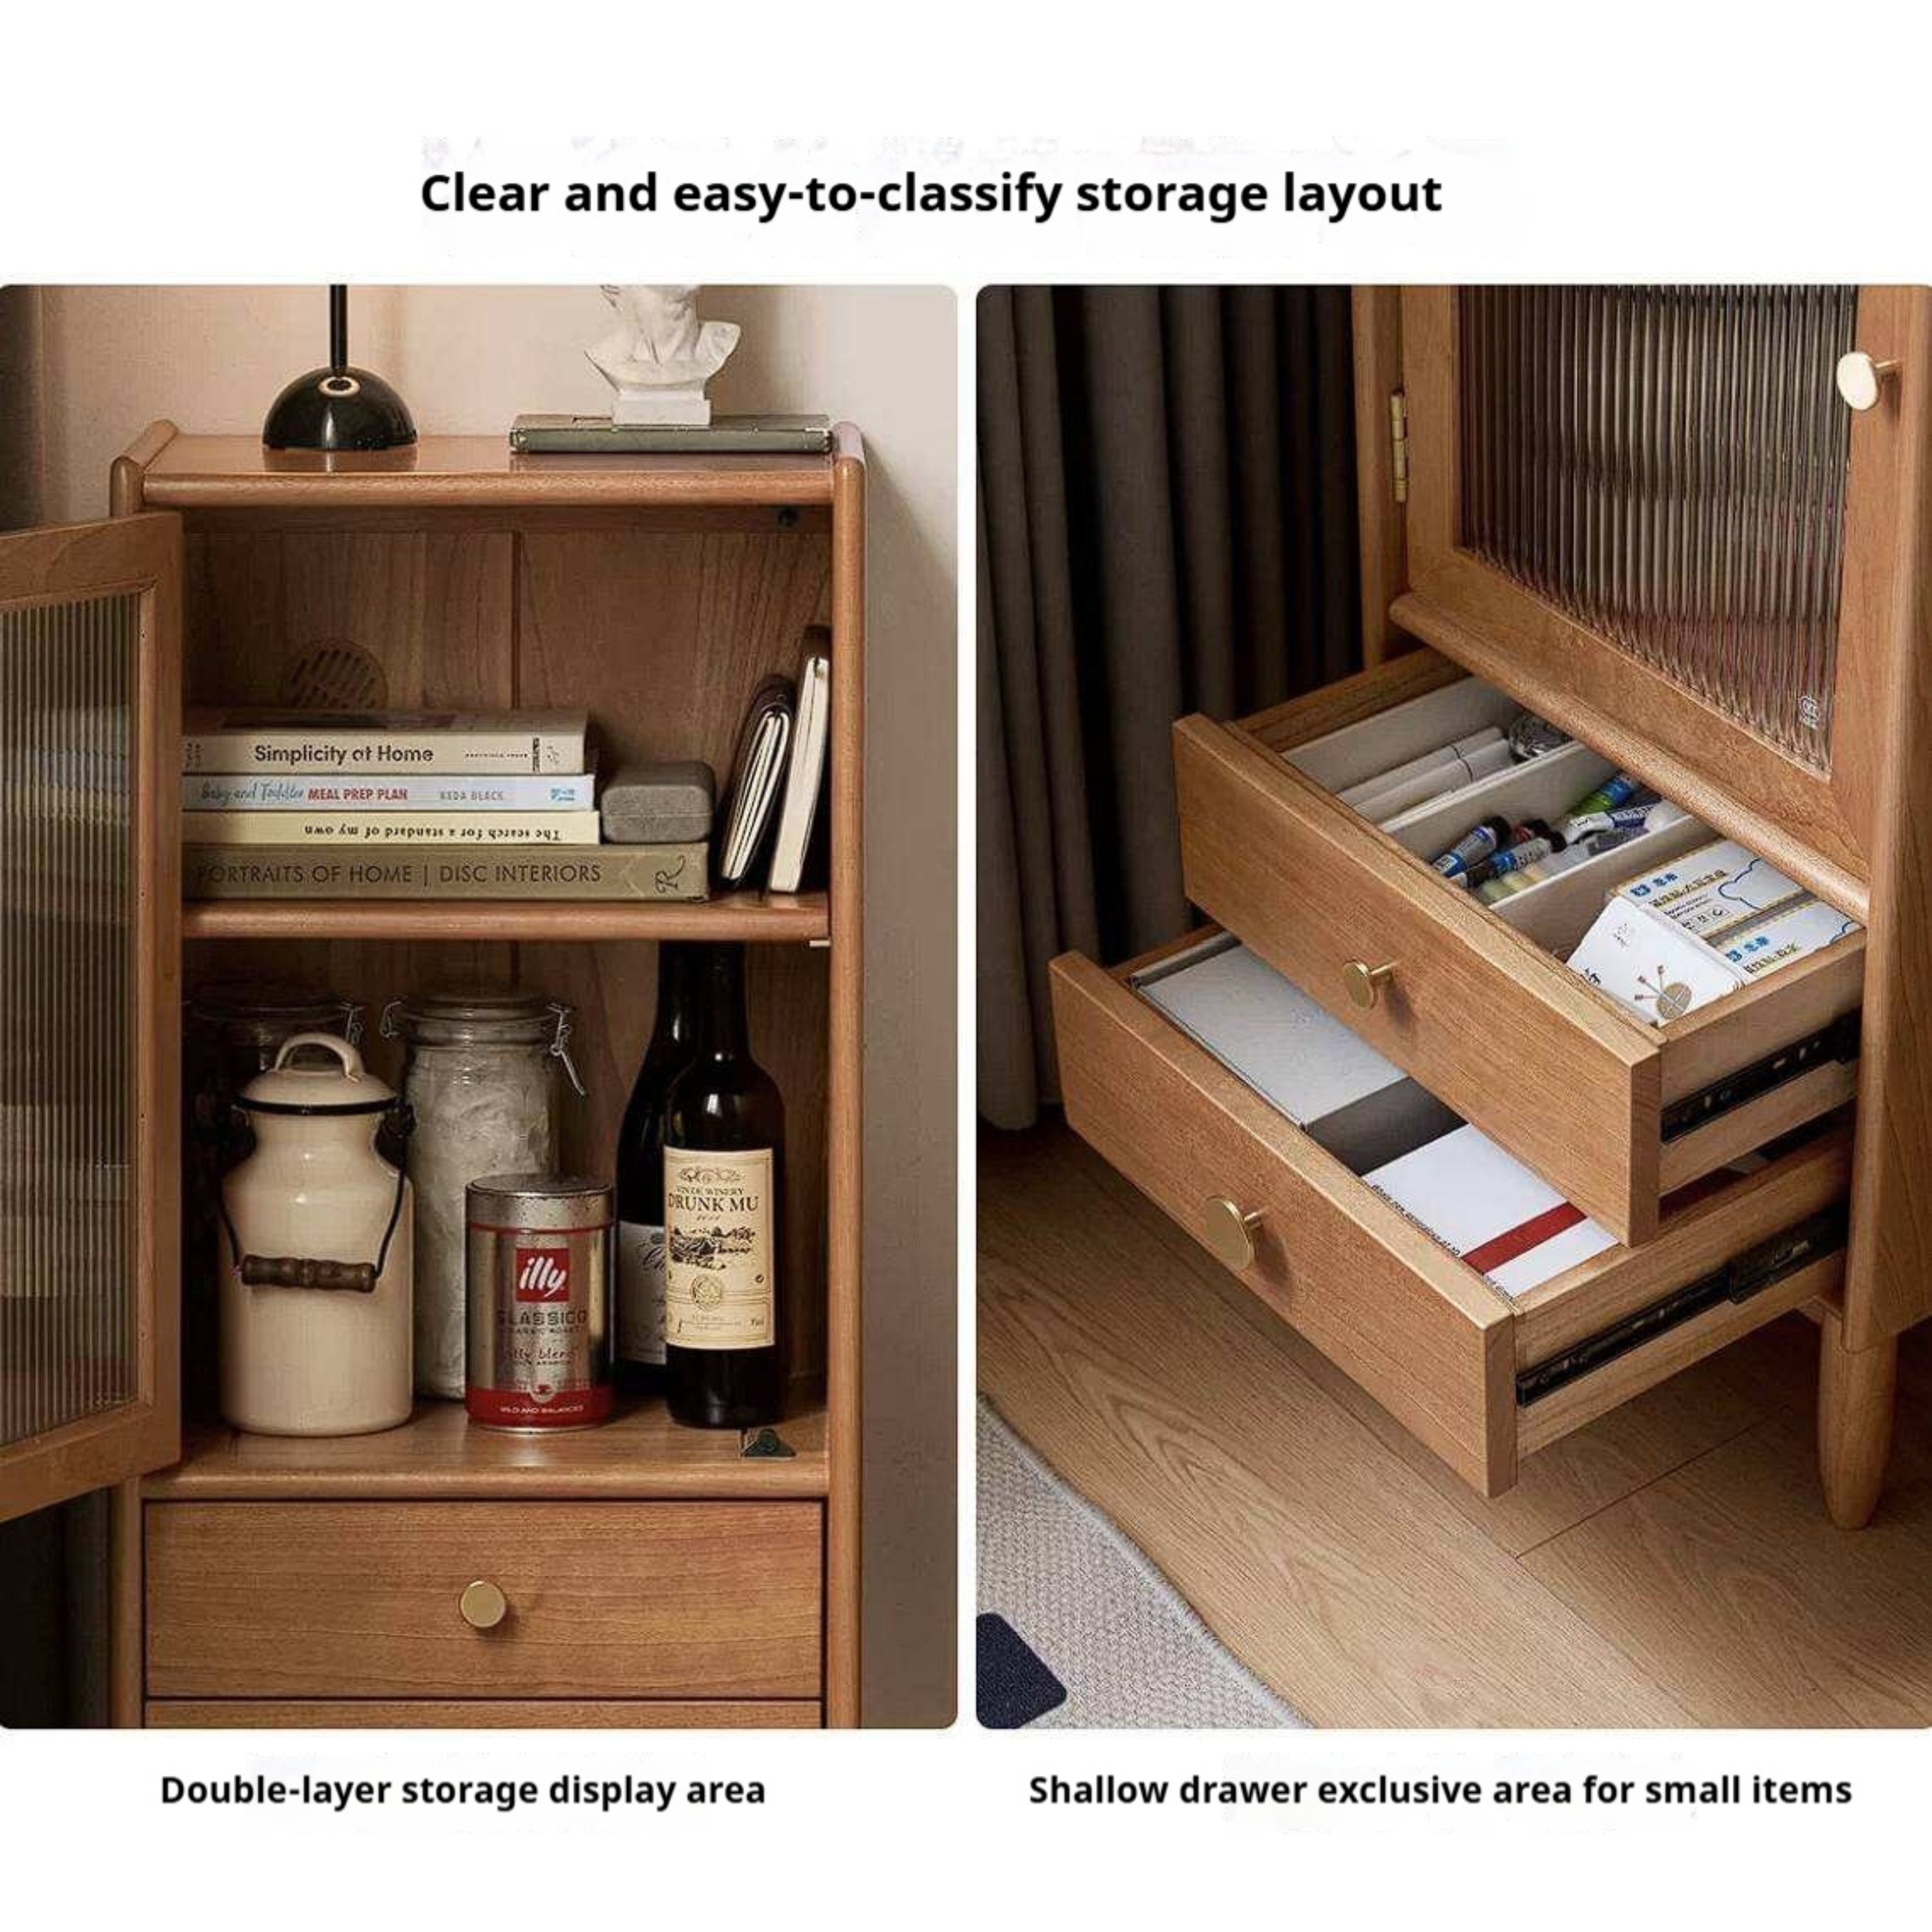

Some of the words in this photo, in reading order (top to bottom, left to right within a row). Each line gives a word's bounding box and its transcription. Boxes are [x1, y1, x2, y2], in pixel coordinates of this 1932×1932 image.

[254, 744, 346, 766] Simplicity
[352, 745, 372, 761] at
[378, 745, 434, 761] Home
[307, 788, 341, 801] MEAL
[343, 788, 373, 801] PREP
[377, 788, 408, 801] PLAN
[305, 825, 334, 835] own
[339, 823, 359, 835] my
[364, 826, 380, 839] of
[385, 827, 444, 839] standard
[461, 828, 483, 841] for
[489, 829, 530, 839] search
[537, 829, 560, 841] The
[197, 865, 303, 883] PORTRAITS
[312, 865, 342, 883] OF
[349, 865, 413, 883] HOME
[440, 865, 487, 883] DISC
[495, 865, 600, 883] INTERIORS
[667, 1192, 724, 1212] DRUNK
[729, 1195, 759, 1212] MU
[519, 1256, 567, 1298] illy
